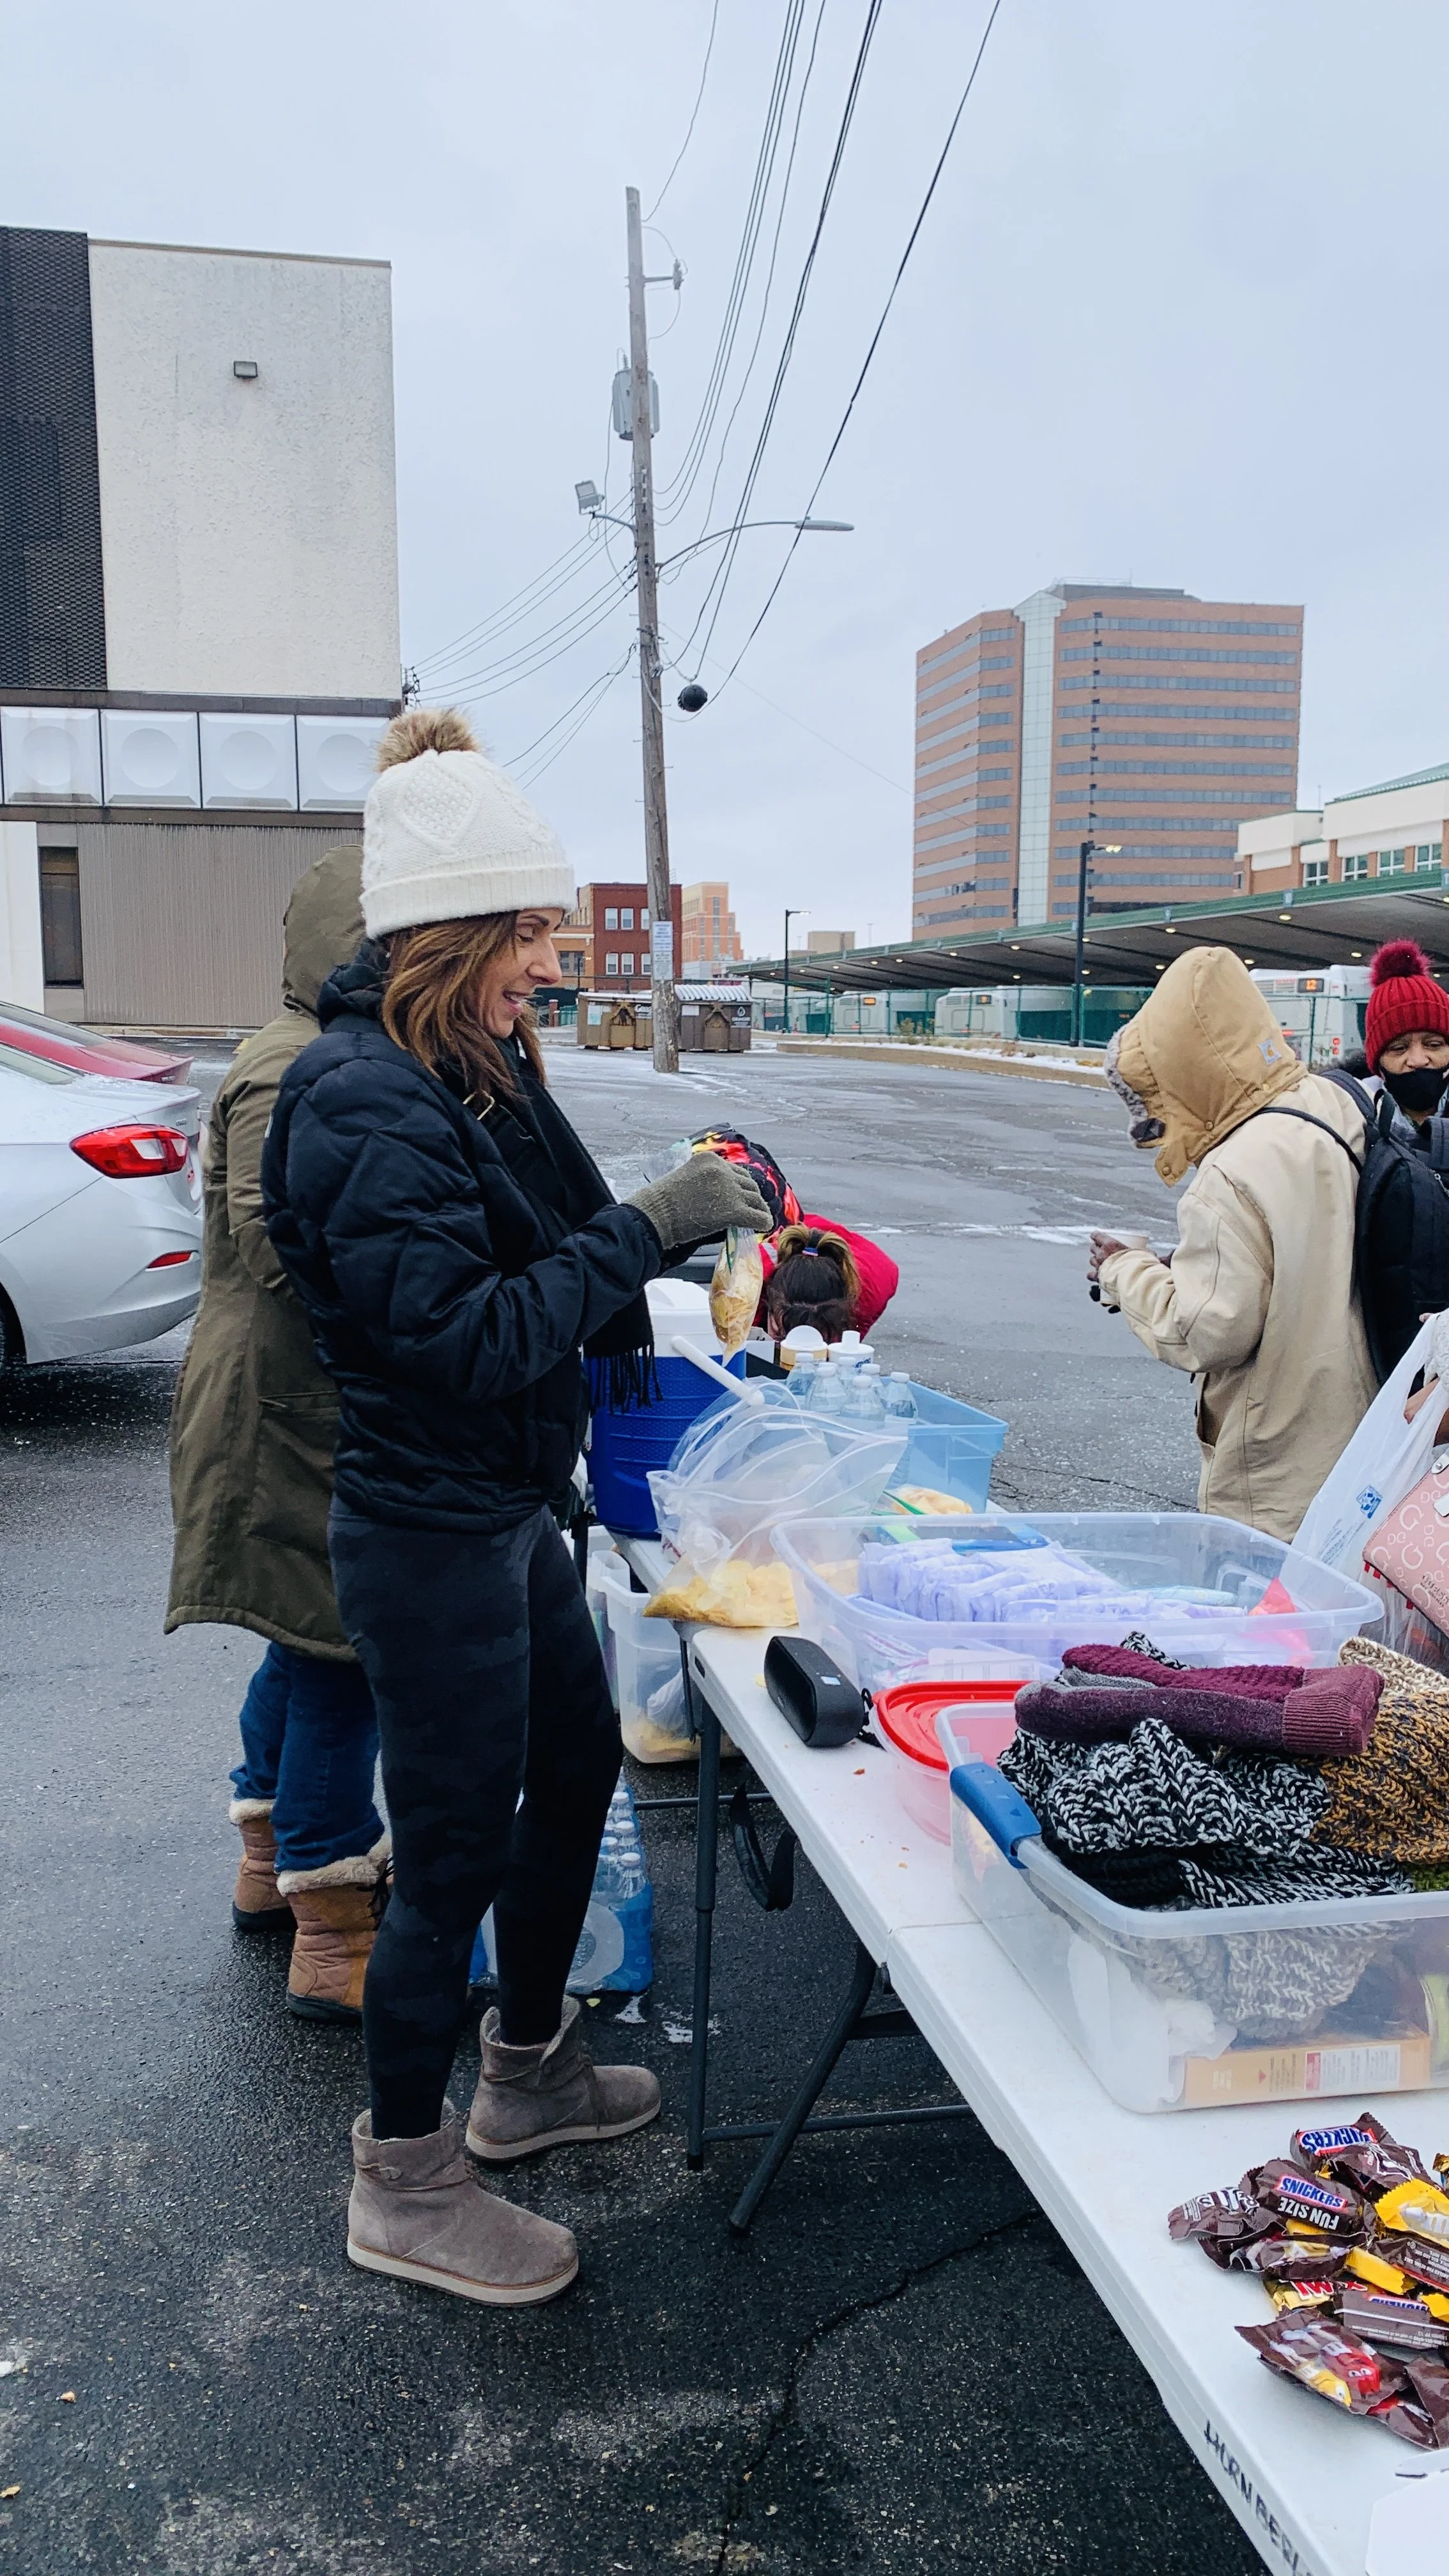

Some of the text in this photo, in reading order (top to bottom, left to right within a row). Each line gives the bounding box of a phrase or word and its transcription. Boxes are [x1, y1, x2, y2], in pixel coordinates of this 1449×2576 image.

[1301, 2128, 1370, 2154] ICKERS
[1280, 2177, 1342, 2207] SNICKERS
[1278, 2196, 1340, 2230] FUN SIZE
